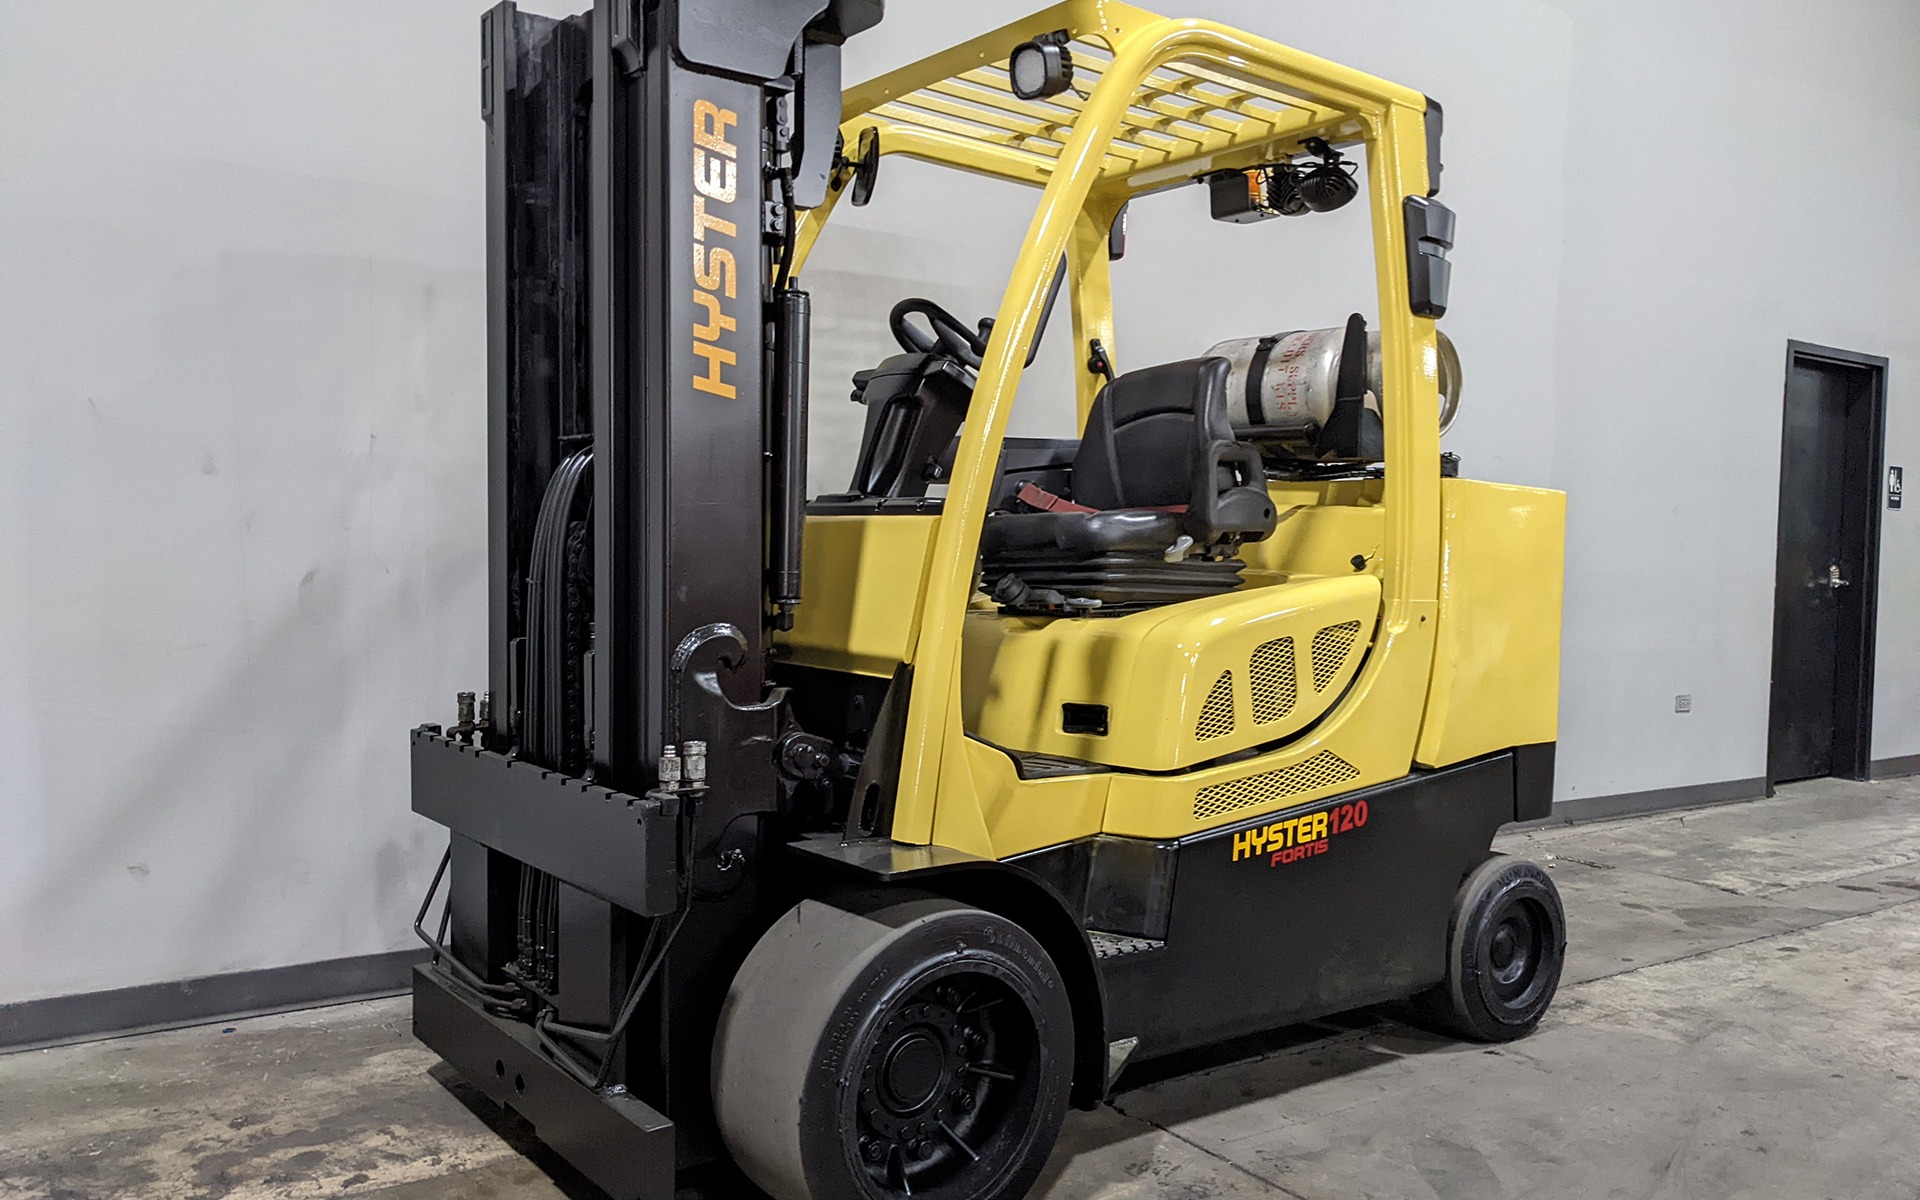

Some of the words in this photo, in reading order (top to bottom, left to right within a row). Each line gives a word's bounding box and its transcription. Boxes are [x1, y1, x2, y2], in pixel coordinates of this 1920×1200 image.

[693, 99, 737, 400] HYSTER
[1232, 811, 1329, 862] HYSTER
[1329, 800, 1368, 835] 120
[1270, 838, 1329, 868] FORTIS
